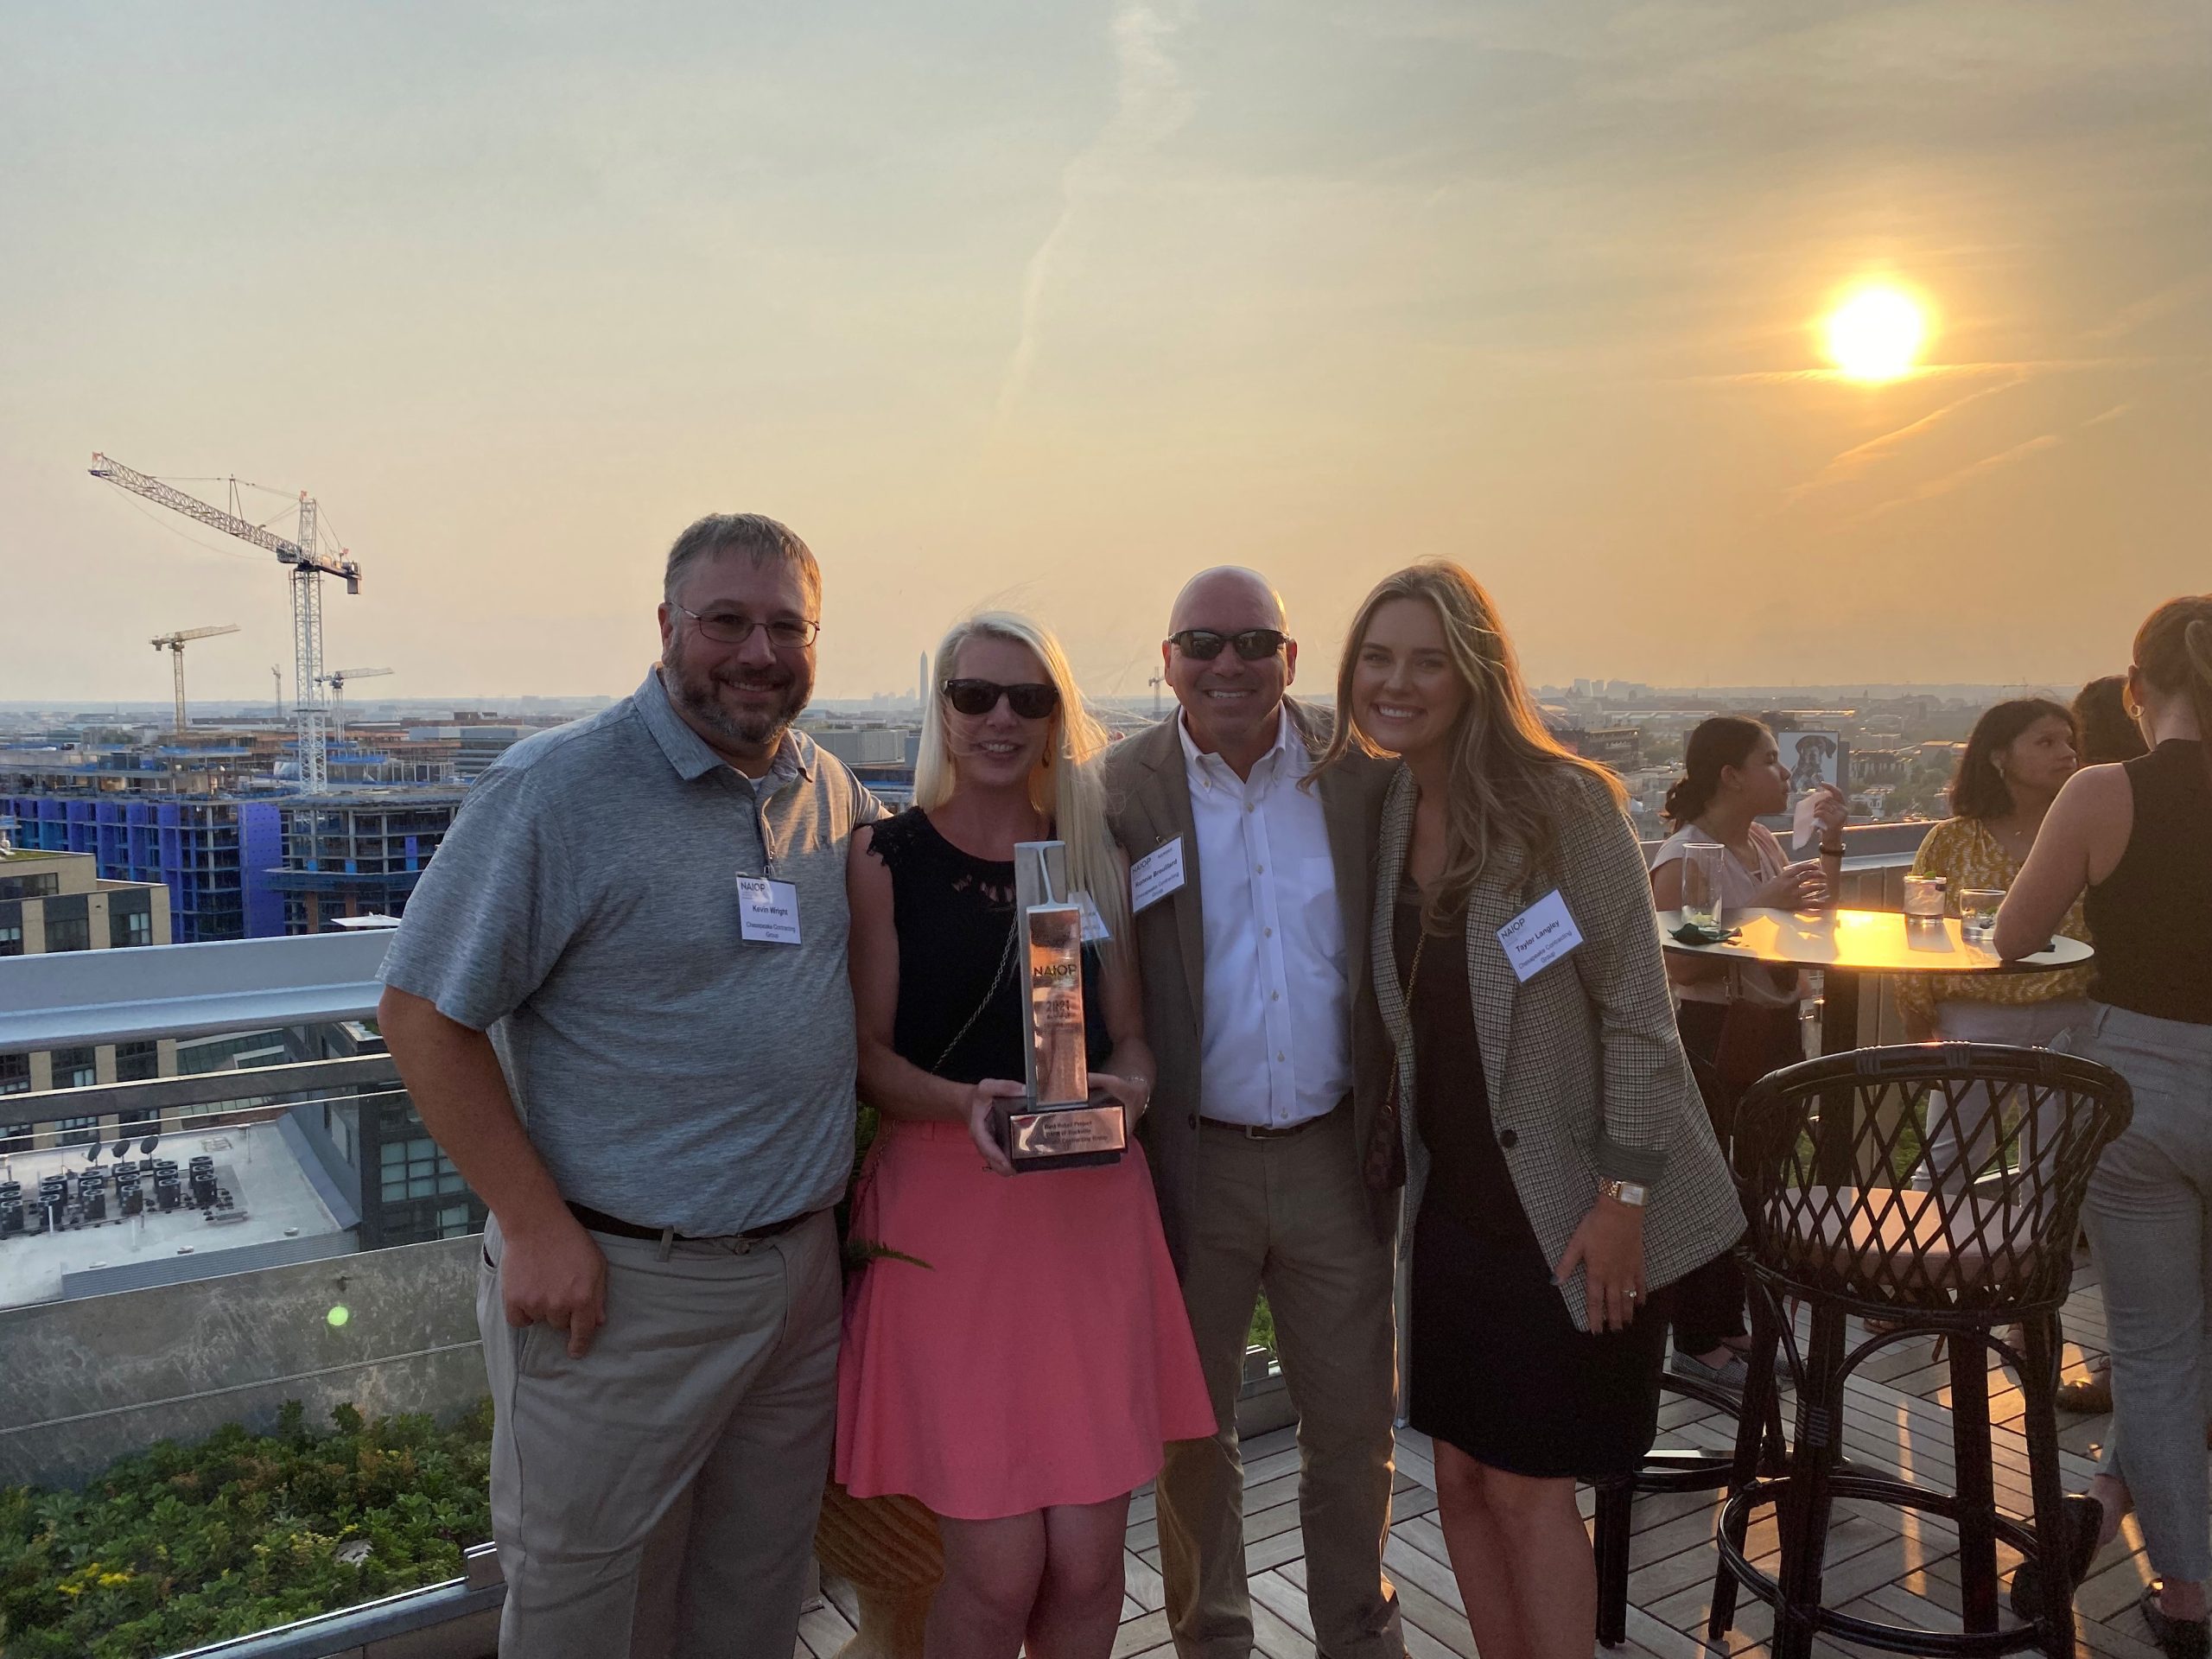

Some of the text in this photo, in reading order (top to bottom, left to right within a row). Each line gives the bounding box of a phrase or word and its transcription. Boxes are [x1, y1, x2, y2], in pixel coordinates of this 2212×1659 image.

[741, 881, 766, 892] NAIOP
[752, 905, 789, 917] Kevin Wright
[1500, 918, 1526, 940] NAIOP
[1515, 937, 1535, 953] Taylor
[1535, 919, 1560, 940] Langley
[1033, 963, 1077, 977] NAIOP
